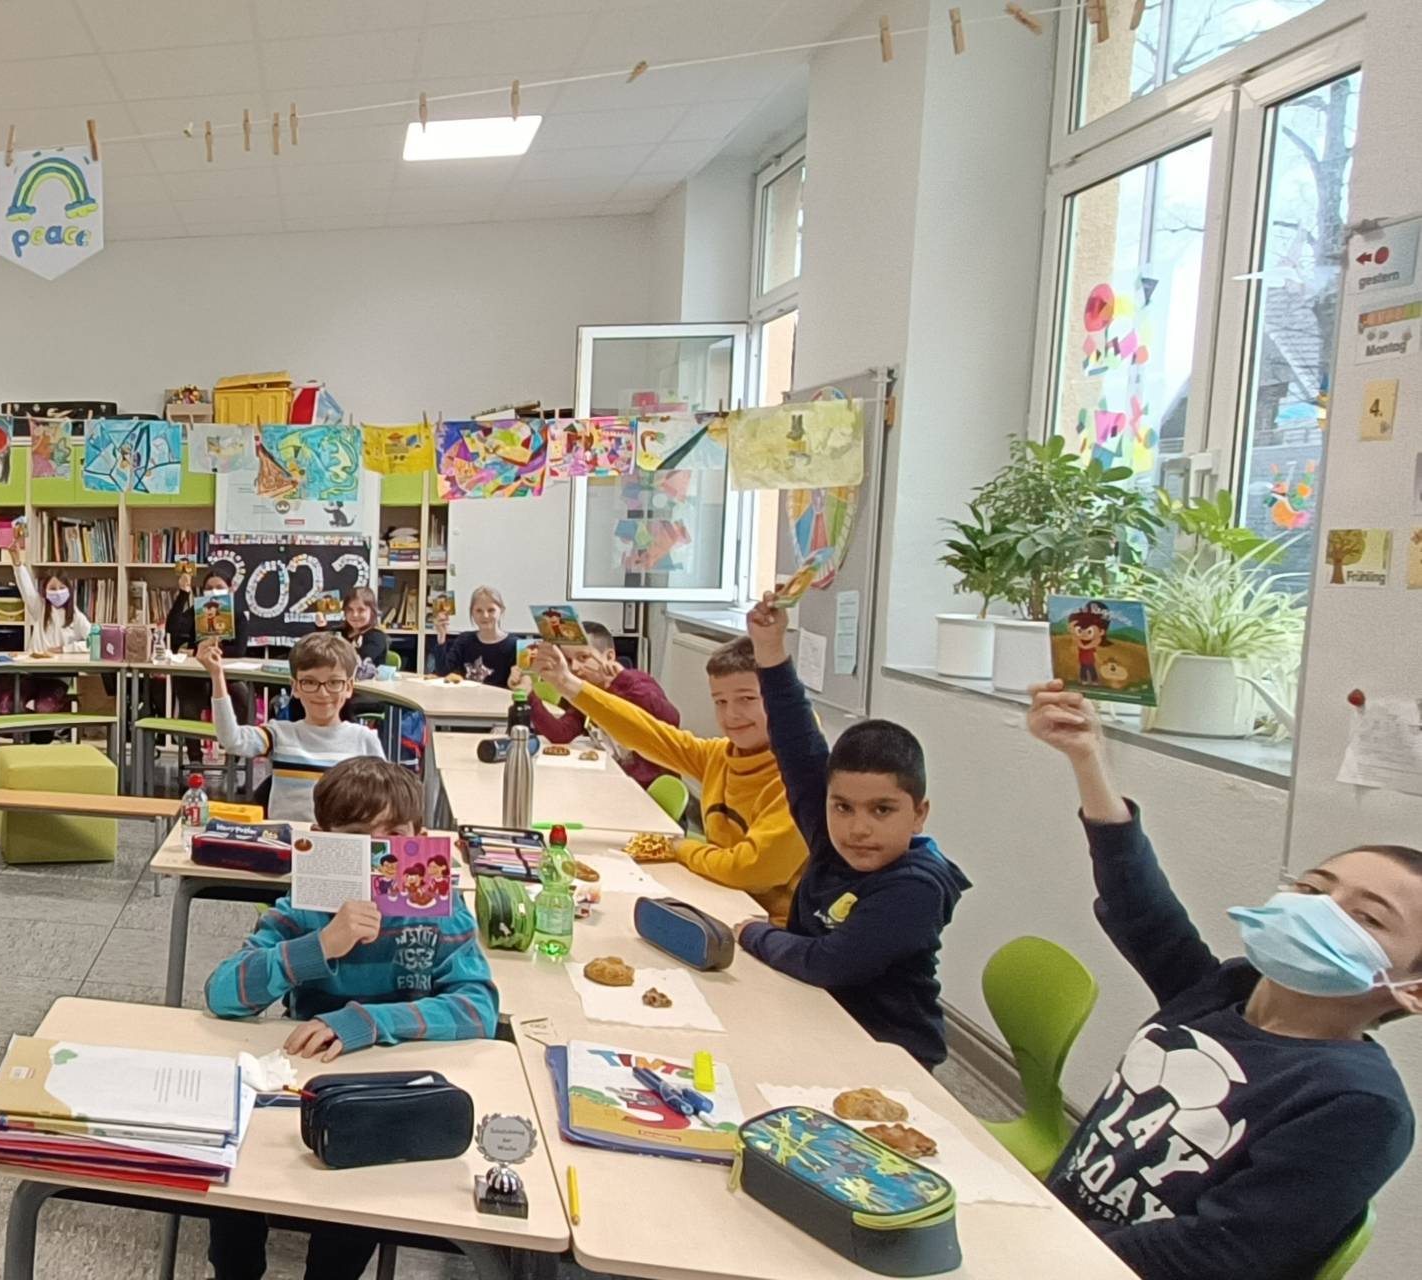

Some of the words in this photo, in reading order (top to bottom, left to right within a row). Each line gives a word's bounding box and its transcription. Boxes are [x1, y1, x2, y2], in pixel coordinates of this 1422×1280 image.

[11, 225, 91, 258] peace
[1358, 271, 1400, 290] gestern
[1365, 340, 1408, 357] Montag
[1345, 569, 1386, 586] Frühling
